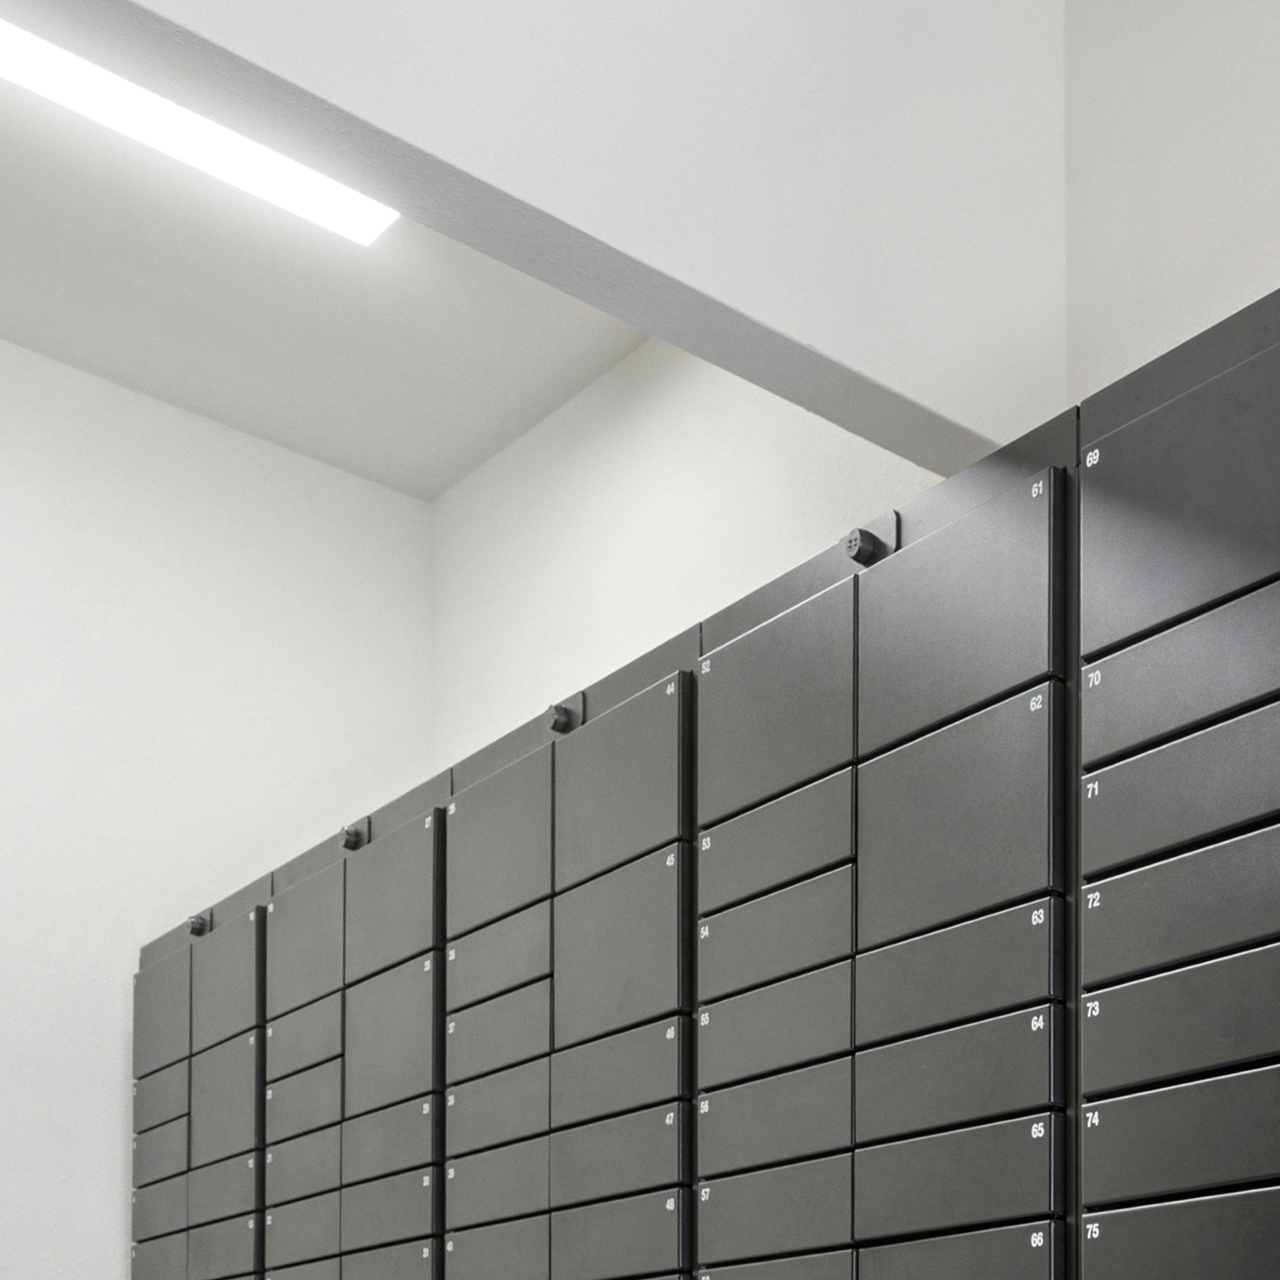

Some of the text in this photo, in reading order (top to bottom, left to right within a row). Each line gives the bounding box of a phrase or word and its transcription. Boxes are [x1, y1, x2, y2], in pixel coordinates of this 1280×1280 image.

[1085, 448, 1100, 468] 69
[1031, 480, 1044, 499] 61
[1087, 669, 1102, 688] 70
[1029, 694, 1044, 712] 62
[1086, 780, 1099, 799] 71
[1086, 891, 1101, 909] 72
[1031, 908, 1045, 926] 63
[1086, 1000, 1100, 1018] 73
[1030, 1014, 1045, 1032] 64
[1085, 1111, 1100, 1128] 74
[1031, 1122, 1045, 1139] 65
[1030, 1231, 1044, 1248] 66
[1086, 1222, 1100, 1240] 75
